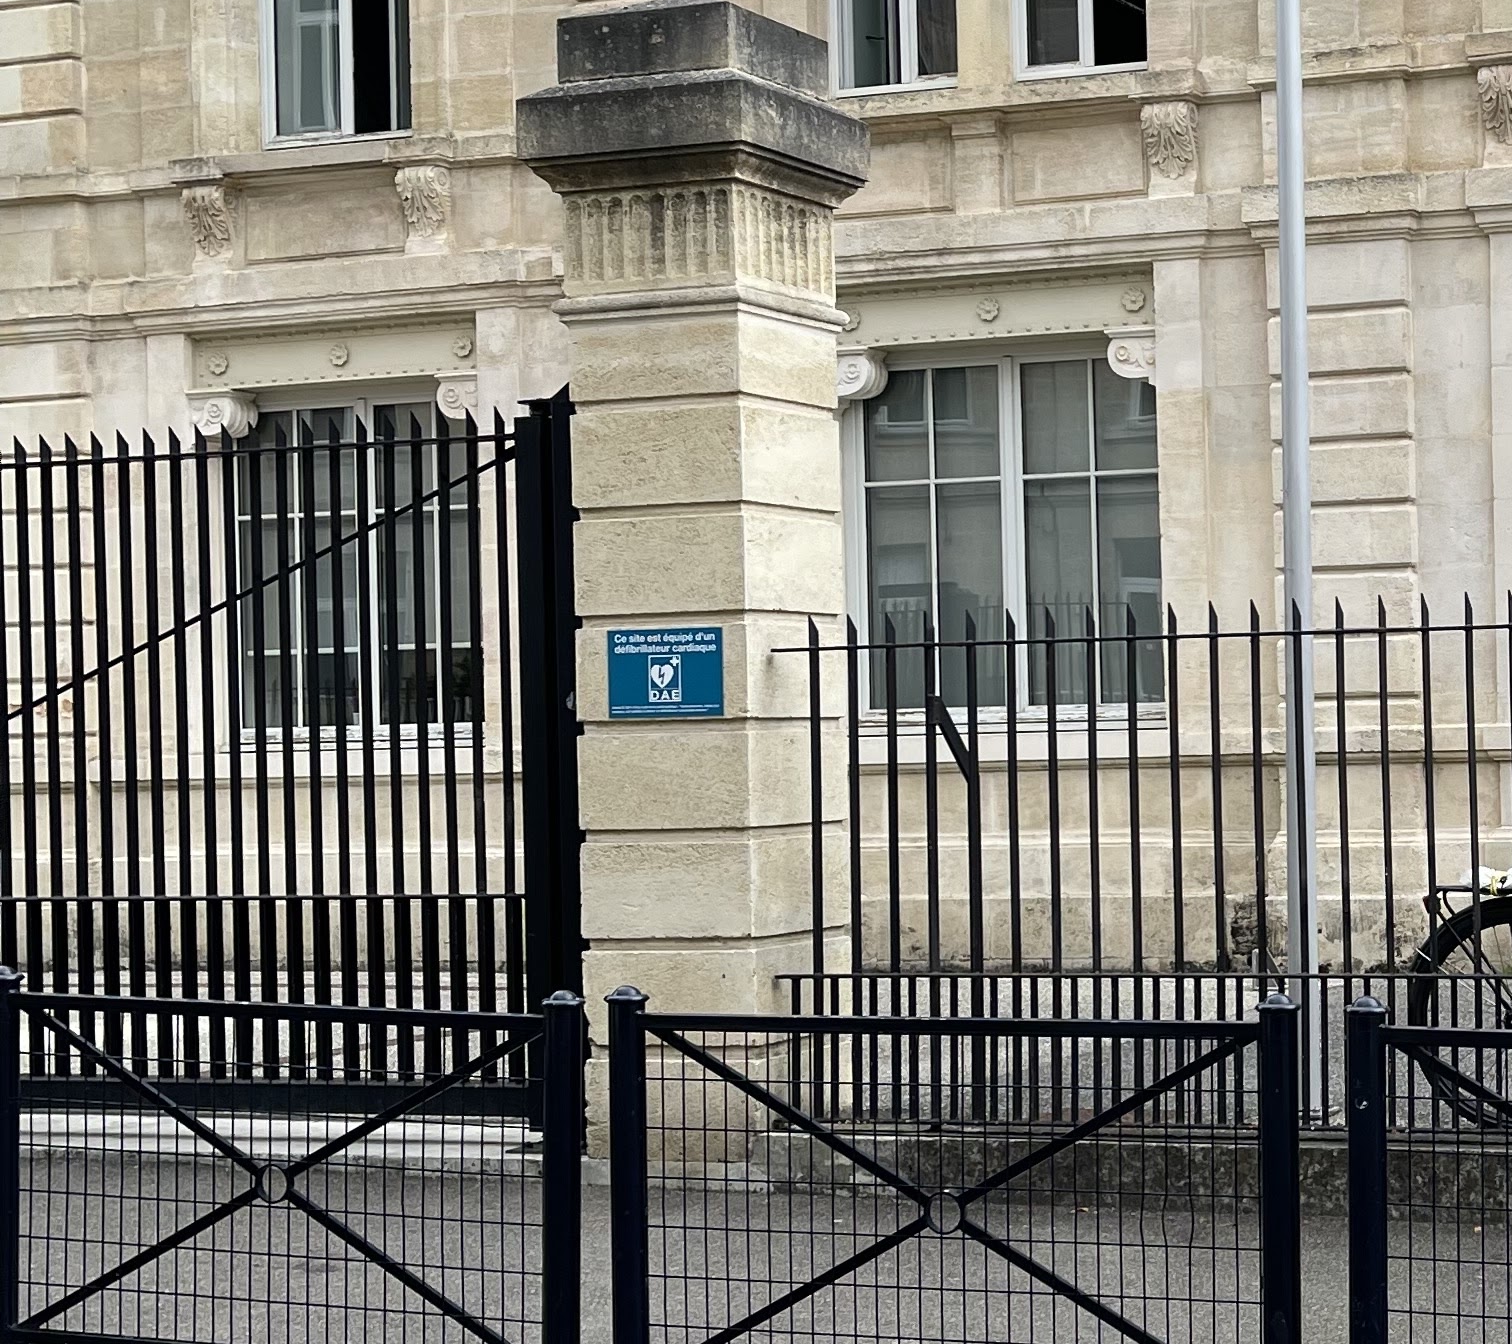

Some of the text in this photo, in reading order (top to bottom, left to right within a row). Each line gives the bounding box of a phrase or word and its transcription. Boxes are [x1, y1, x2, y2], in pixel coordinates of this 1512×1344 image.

[614, 632, 715, 643] Ce site est équipé d'un
[614, 643, 717, 654] défibrillateur cardiaque
[651, 690, 680, 701] DAE
